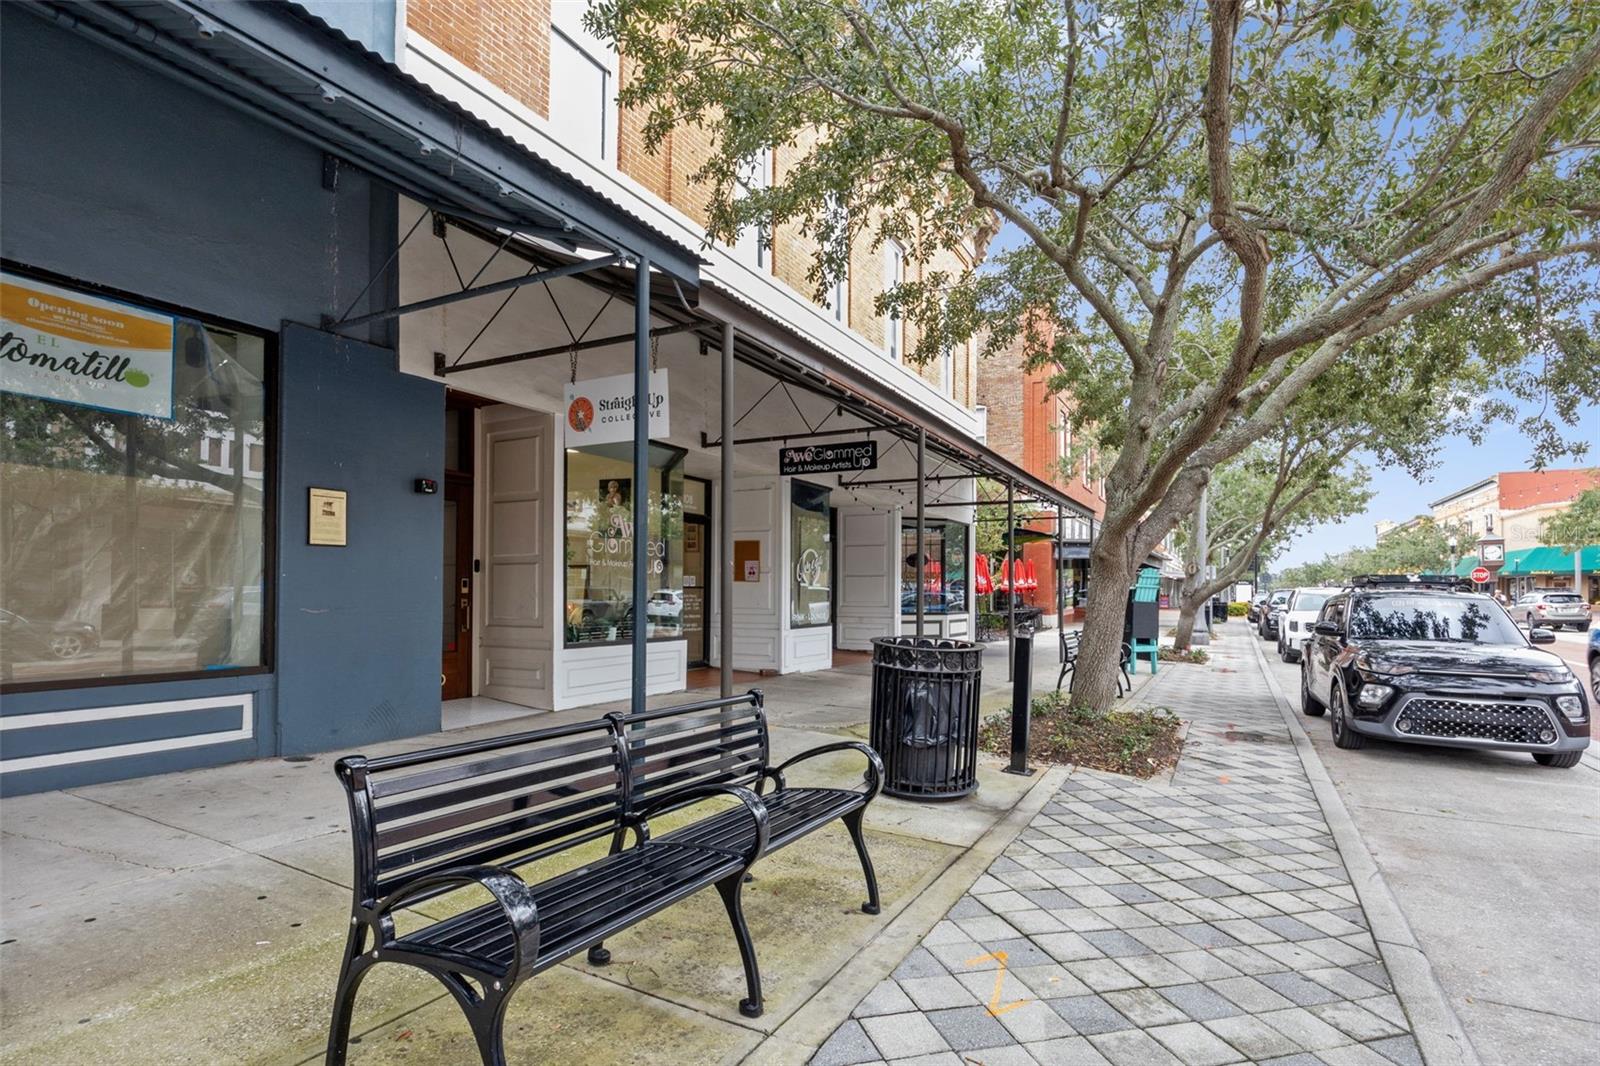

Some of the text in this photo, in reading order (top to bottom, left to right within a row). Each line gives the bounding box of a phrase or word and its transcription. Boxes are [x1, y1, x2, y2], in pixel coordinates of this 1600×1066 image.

[27, 297, 125, 329] Opening soon
[37, 334, 60, 348] EL
[34, 371, 107, 389] TAQUE
[599, 393, 664, 411] Straig Up
[601, 410, 661, 424] COLLEVE
[813, 443, 872, 461] Glammed
[804, 463, 830, 472] Makeup
[831, 461, 852, 469] Artists
[607, 514, 634, 538] Aw
[590, 531, 666, 557] Glamed
[1472, 571, 1489, 579] STOP
